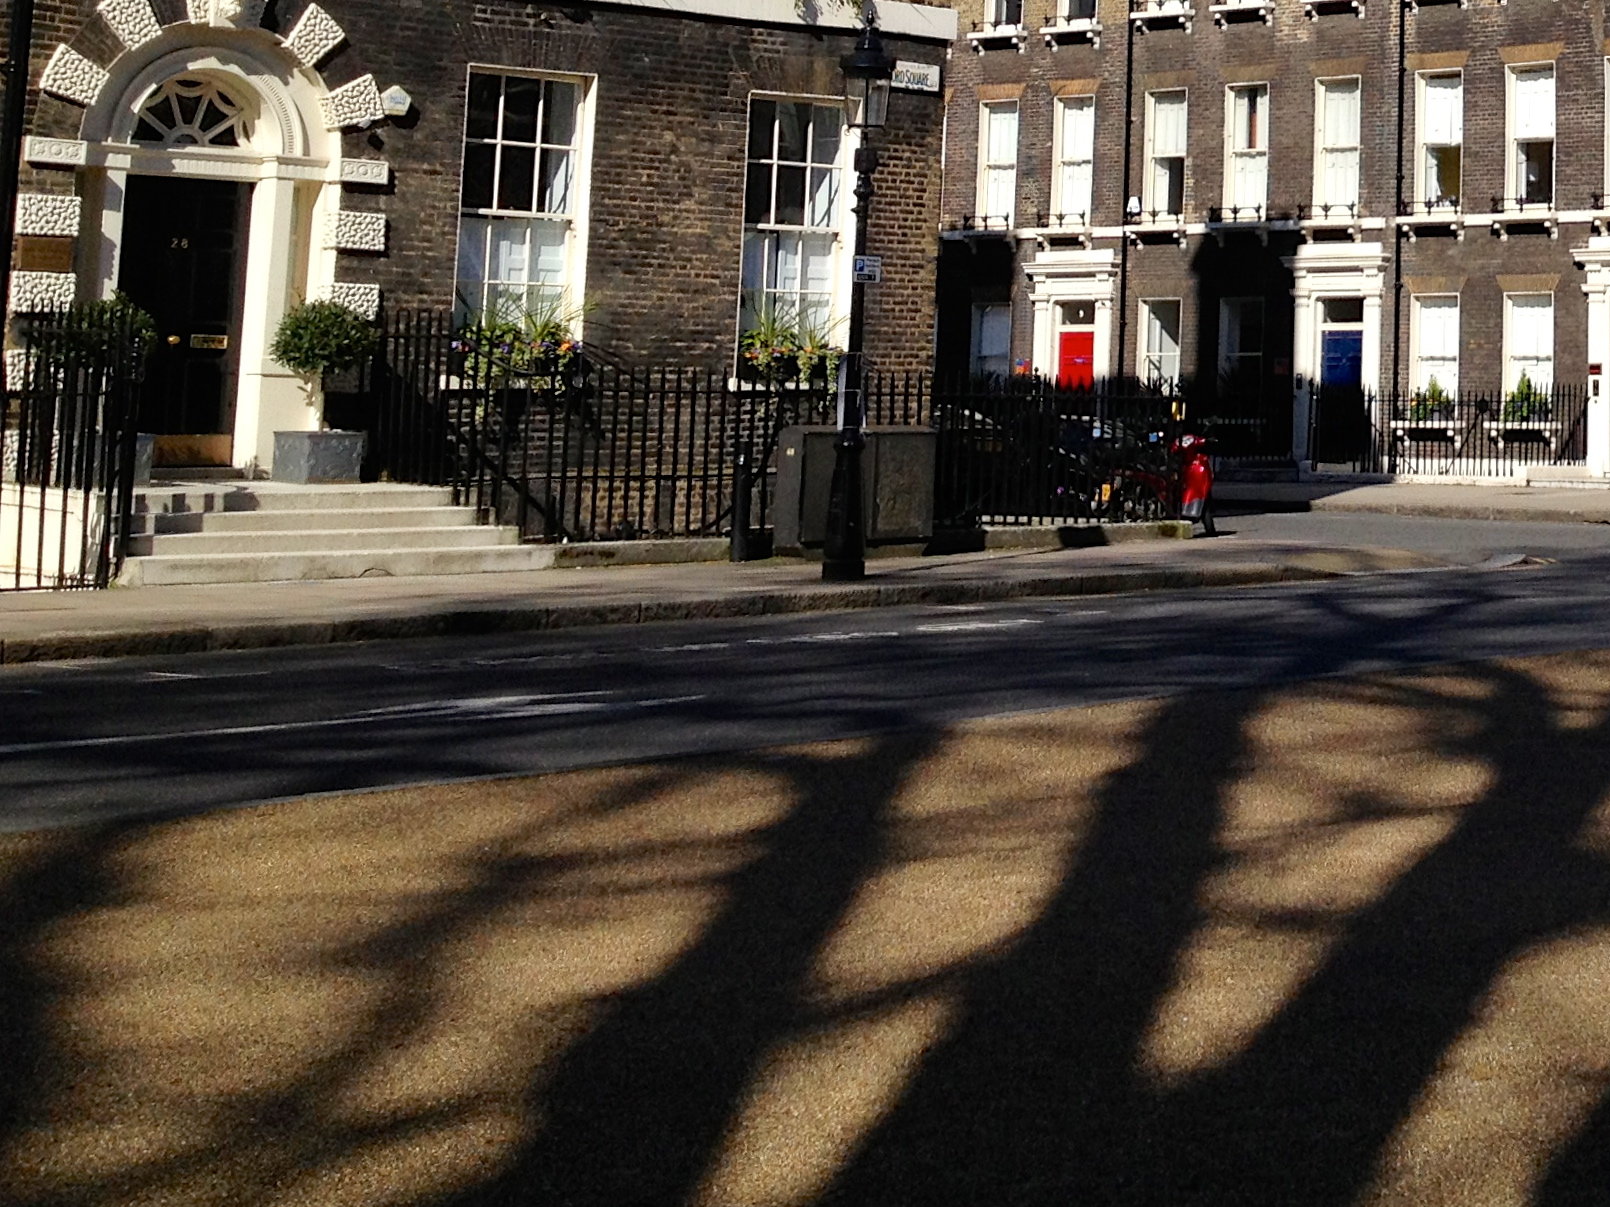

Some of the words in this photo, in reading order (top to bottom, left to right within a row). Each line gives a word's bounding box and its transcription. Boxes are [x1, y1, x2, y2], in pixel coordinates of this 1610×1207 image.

[905, 69, 930, 86] SQUARE
[170, 237, 189, 249] 28
[856, 259, 864, 271] P
